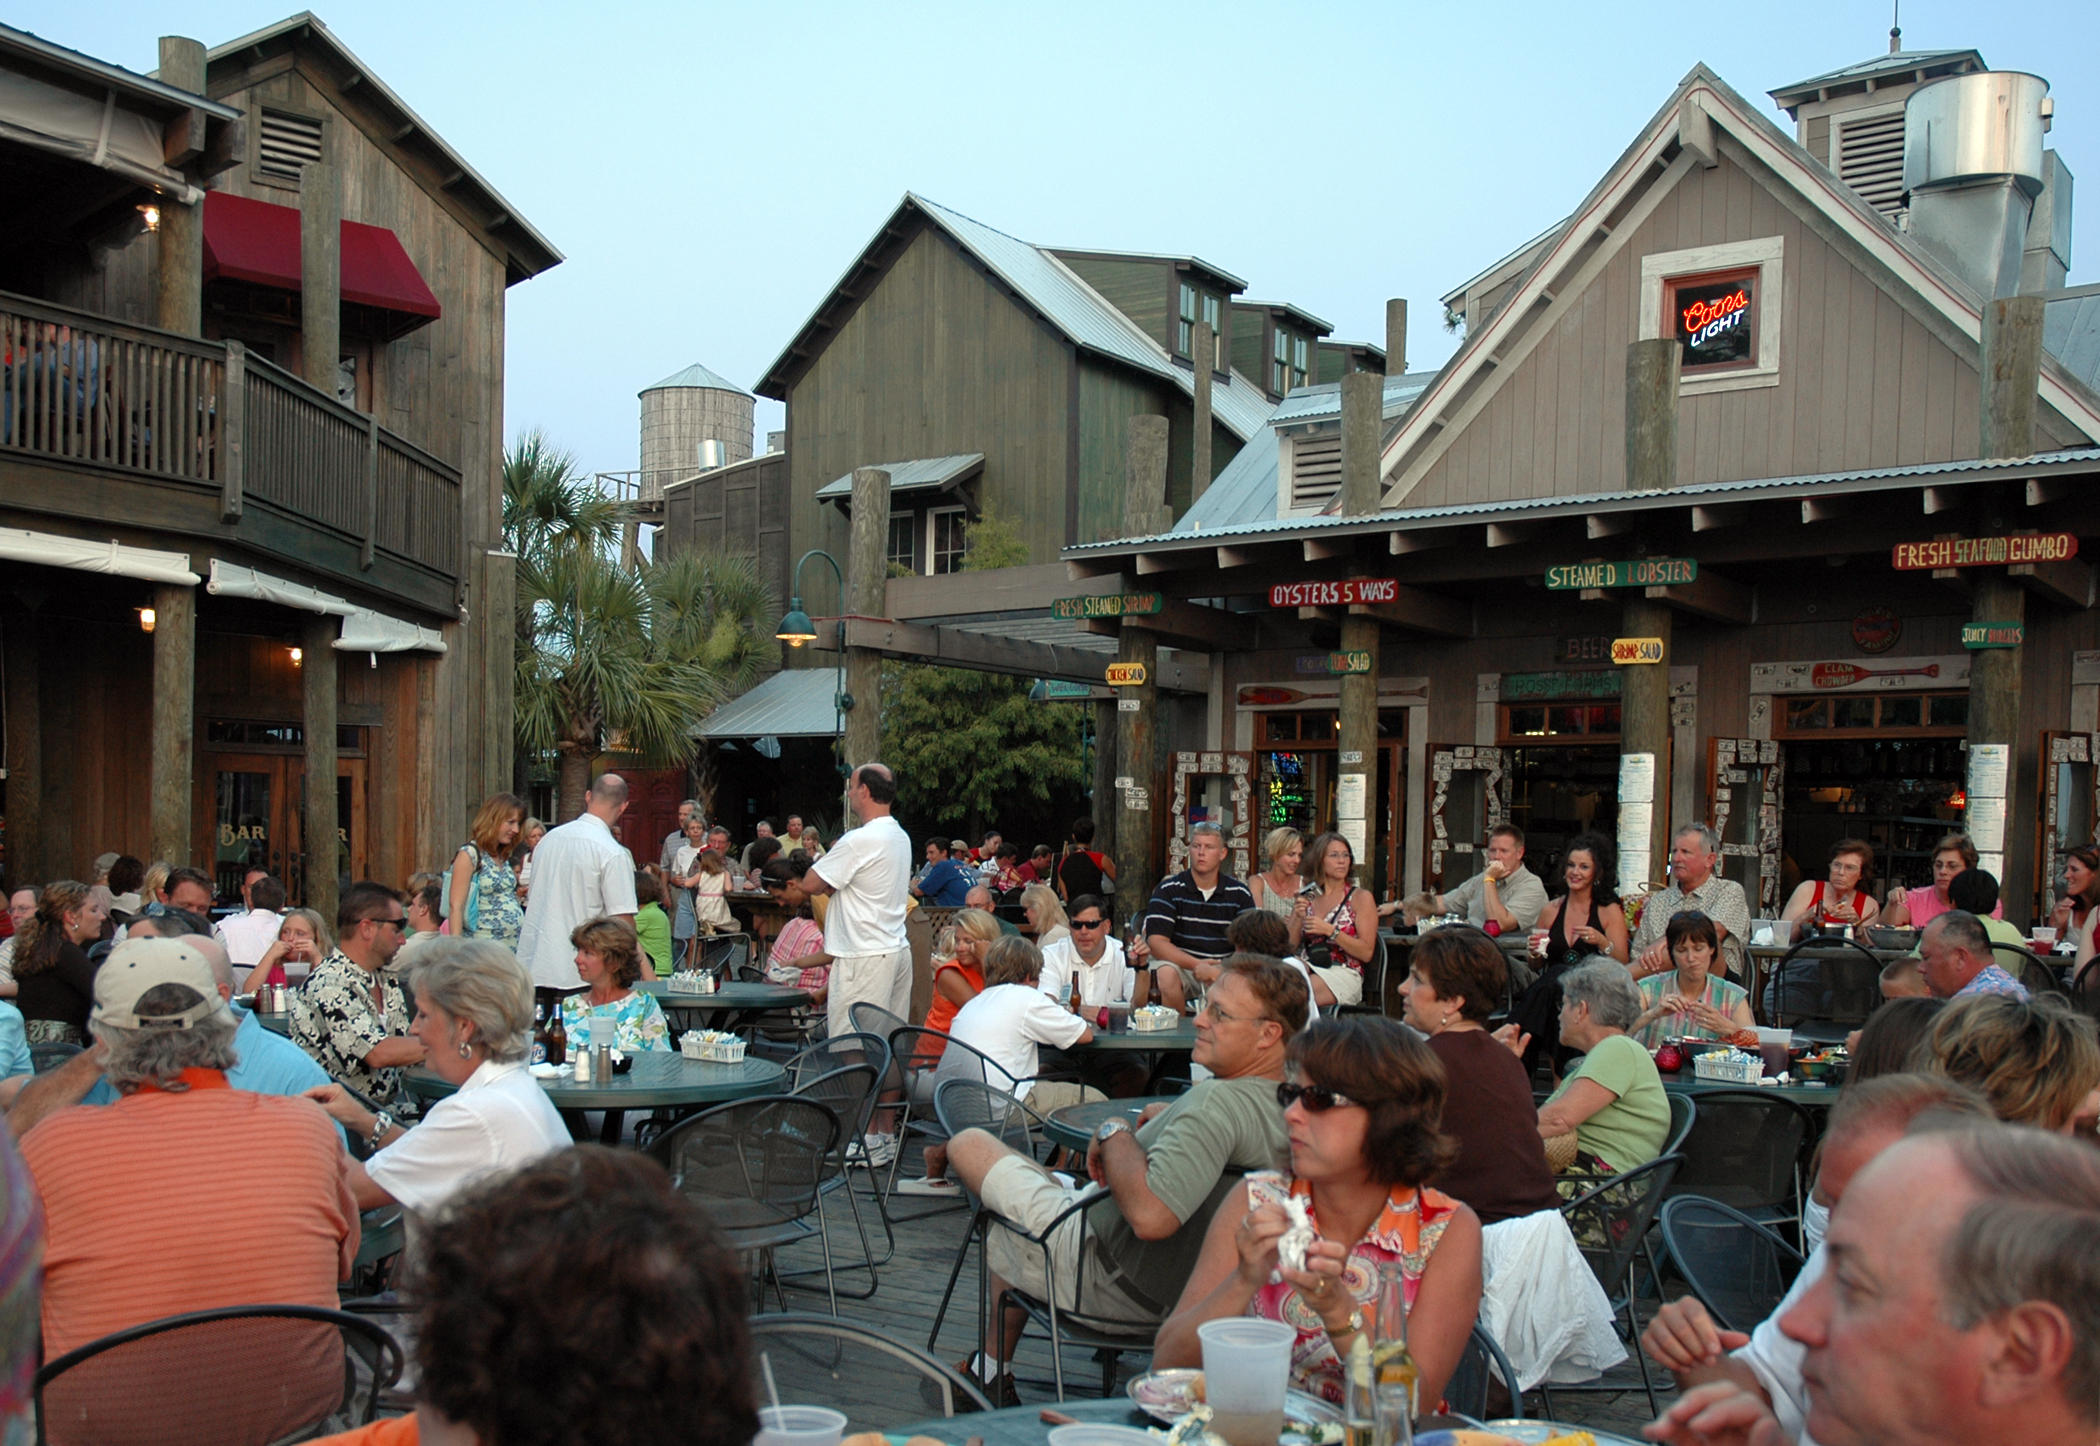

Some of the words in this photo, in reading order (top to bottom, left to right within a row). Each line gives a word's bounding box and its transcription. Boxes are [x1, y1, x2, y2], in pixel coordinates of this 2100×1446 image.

[1683, 289, 1748, 332] Coors
[1690, 309, 1745, 348] LIGHT
[1897, 542, 1951, 568] FRESH
[1954, 537, 2007, 564] SEAFOOD
[2010, 534, 2069, 561] GUMBO
[1549, 564, 1617, 588] STEAMED
[1627, 560, 1693, 584] LOBSTER
[1273, 582, 1340, 606] OYSTERS
[1344, 581, 1354, 603] 5
[1359, 579, 1396, 601] WAYS
[1054, 599, 1084, 617] FRESH
[1085, 596, 1121, 616] STEAMED
[1122, 594, 1155, 613] SHRIMP
[1961, 627, 1987, 643] JUICY
[1348, 652, 1370, 671] SALAD
[1613, 641, 1638, 661] SHRIMP
[1640, 642, 1661, 660] SALAD
[1815, 673, 1856, 687] CHOWDER
[1824, 663, 1855, 674] CLAM
